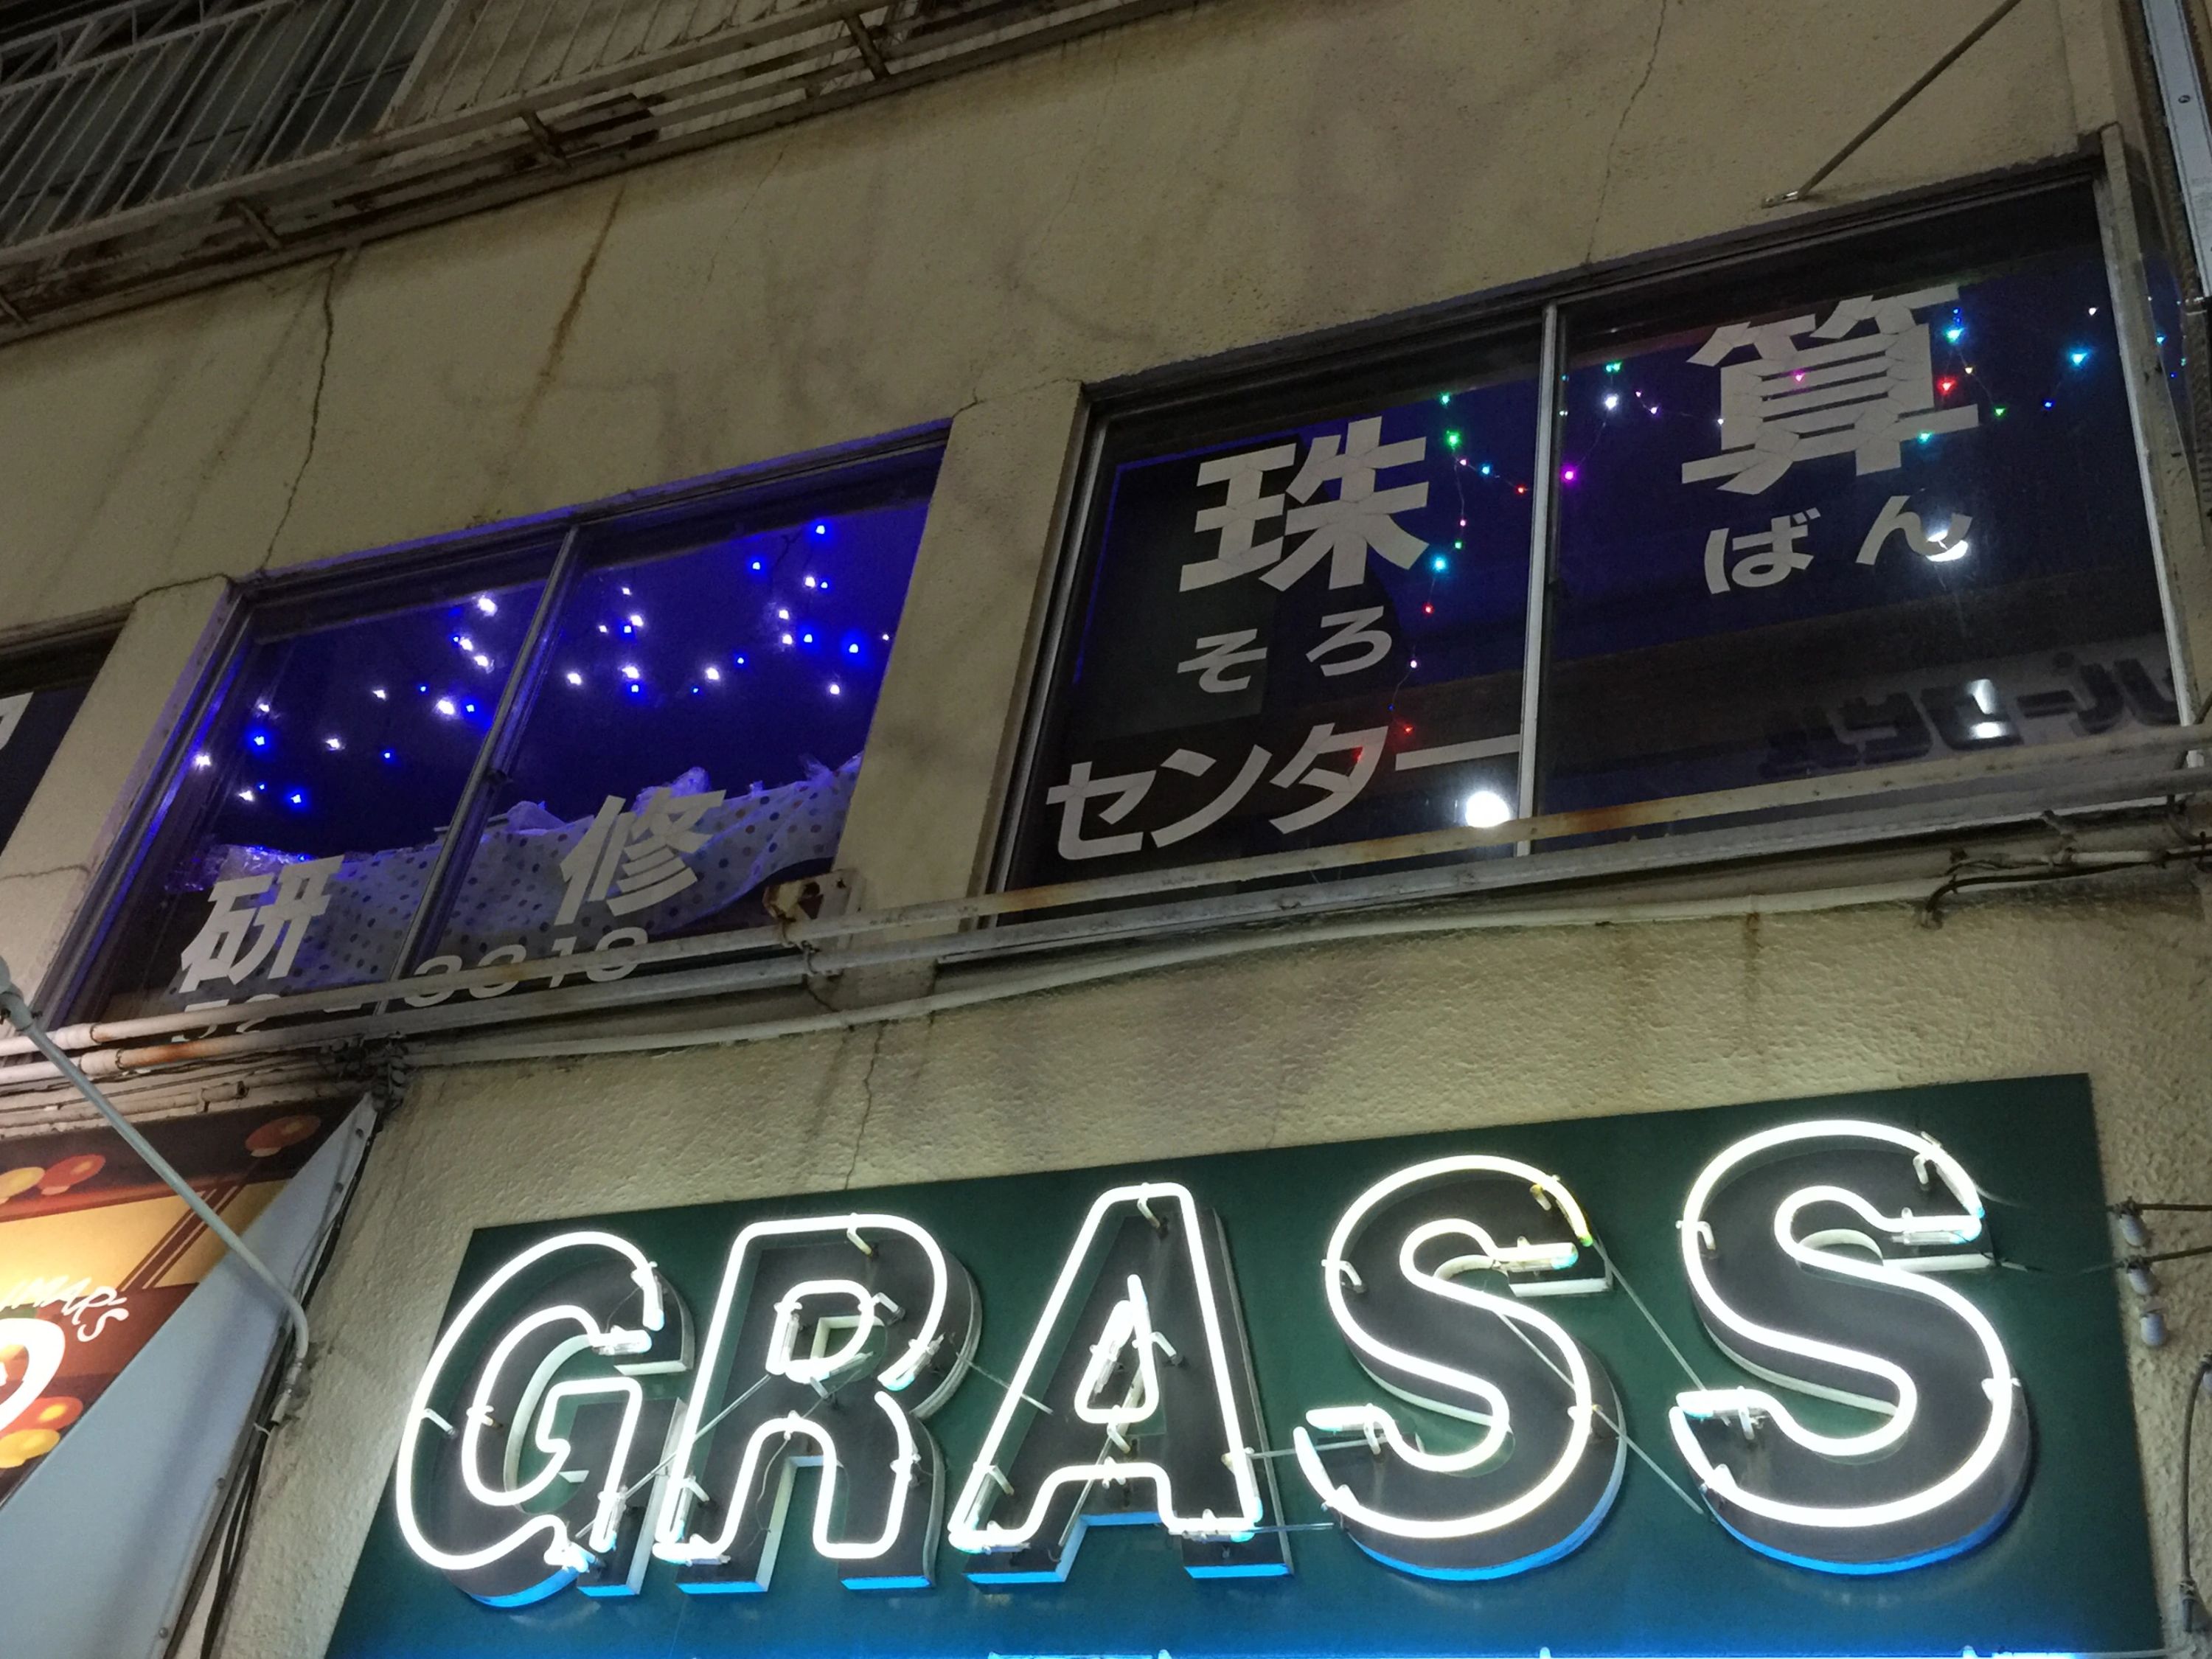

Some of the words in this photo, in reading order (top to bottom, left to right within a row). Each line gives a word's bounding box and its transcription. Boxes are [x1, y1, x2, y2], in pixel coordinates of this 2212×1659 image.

[1046, 723, 1521, 861] センター
[396, 1119, 2032, 1610] GRASS
